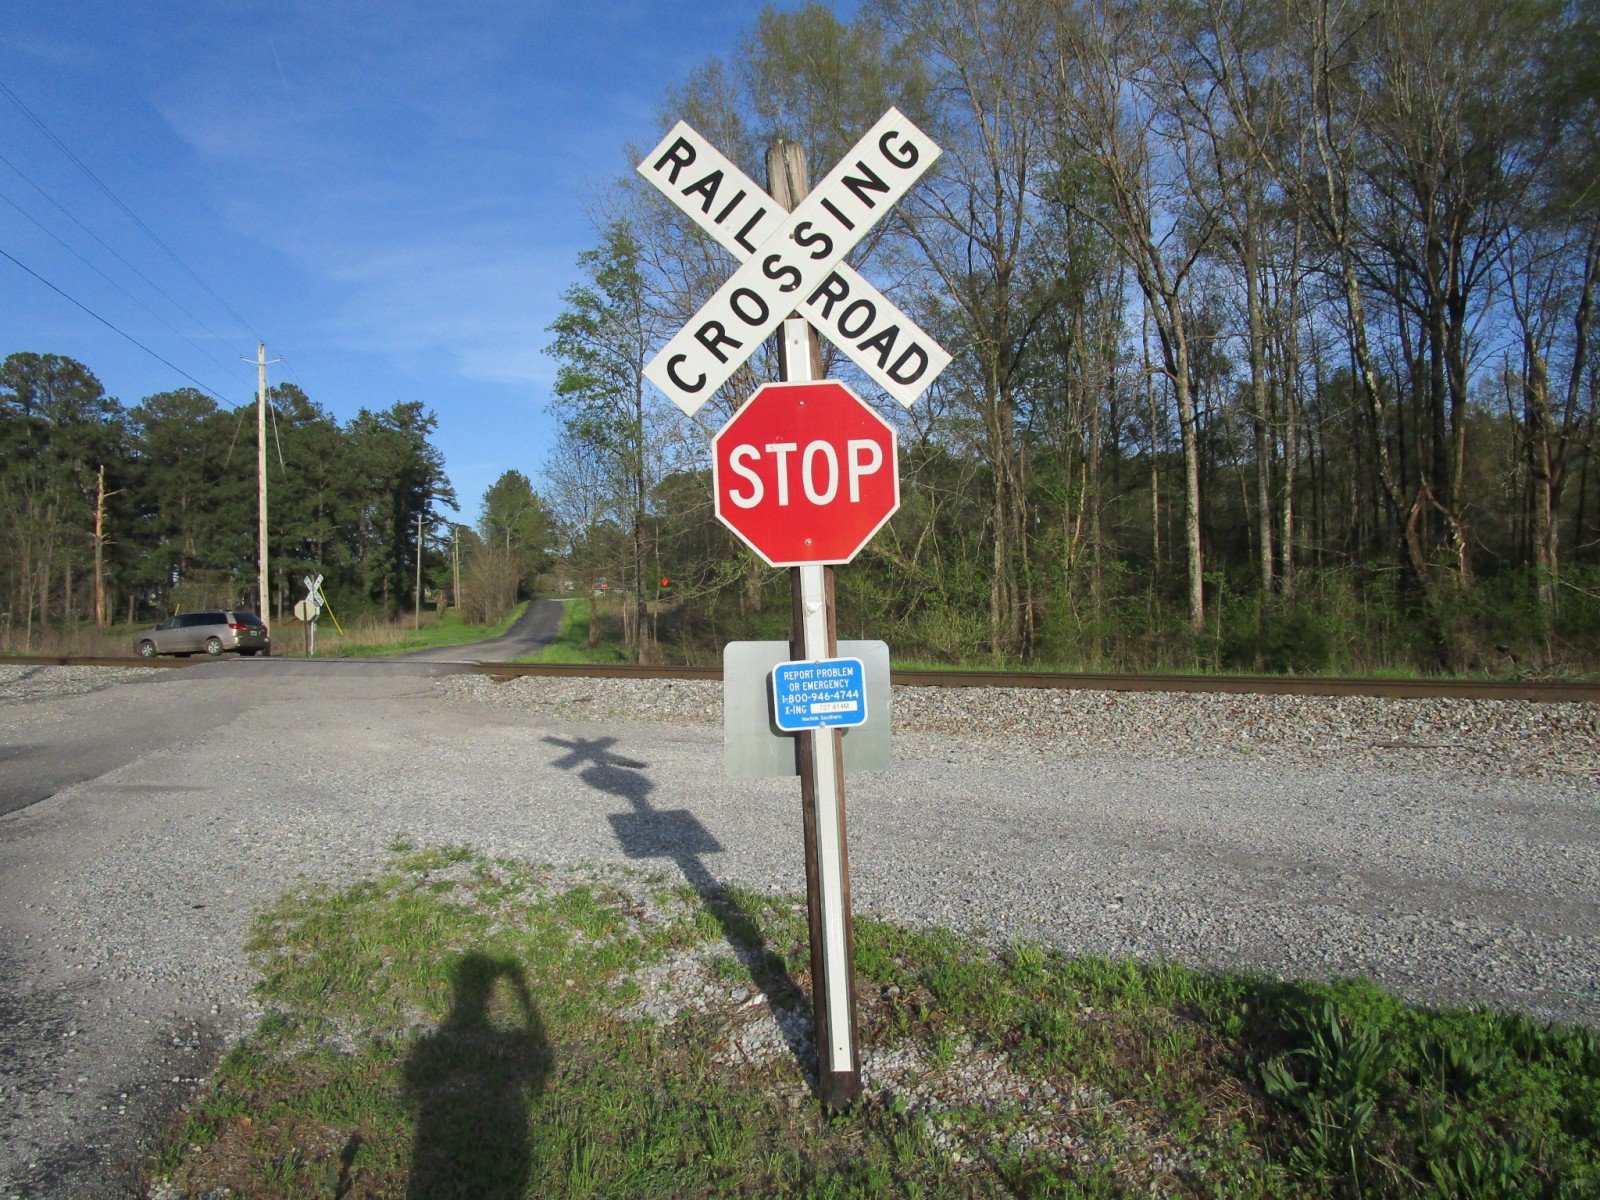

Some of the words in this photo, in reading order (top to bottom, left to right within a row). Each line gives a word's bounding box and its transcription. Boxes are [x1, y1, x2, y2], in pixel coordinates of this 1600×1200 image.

[653, 136, 767, 255] RAIL
[805, 270, 929, 386] ROAD
[666, 130, 920, 394] CROSSING
[728, 438, 883, 509] STOP
[784, 669, 814, 680] REPORT
[816, 667, 853, 678] PROBLEM
[789, 682, 800, 692] OR
[802, 679, 849, 690] EMERGENCY
[781, 689, 860, 704] 1-800-946-4744
[785, 705, 807, 715] X-ING
